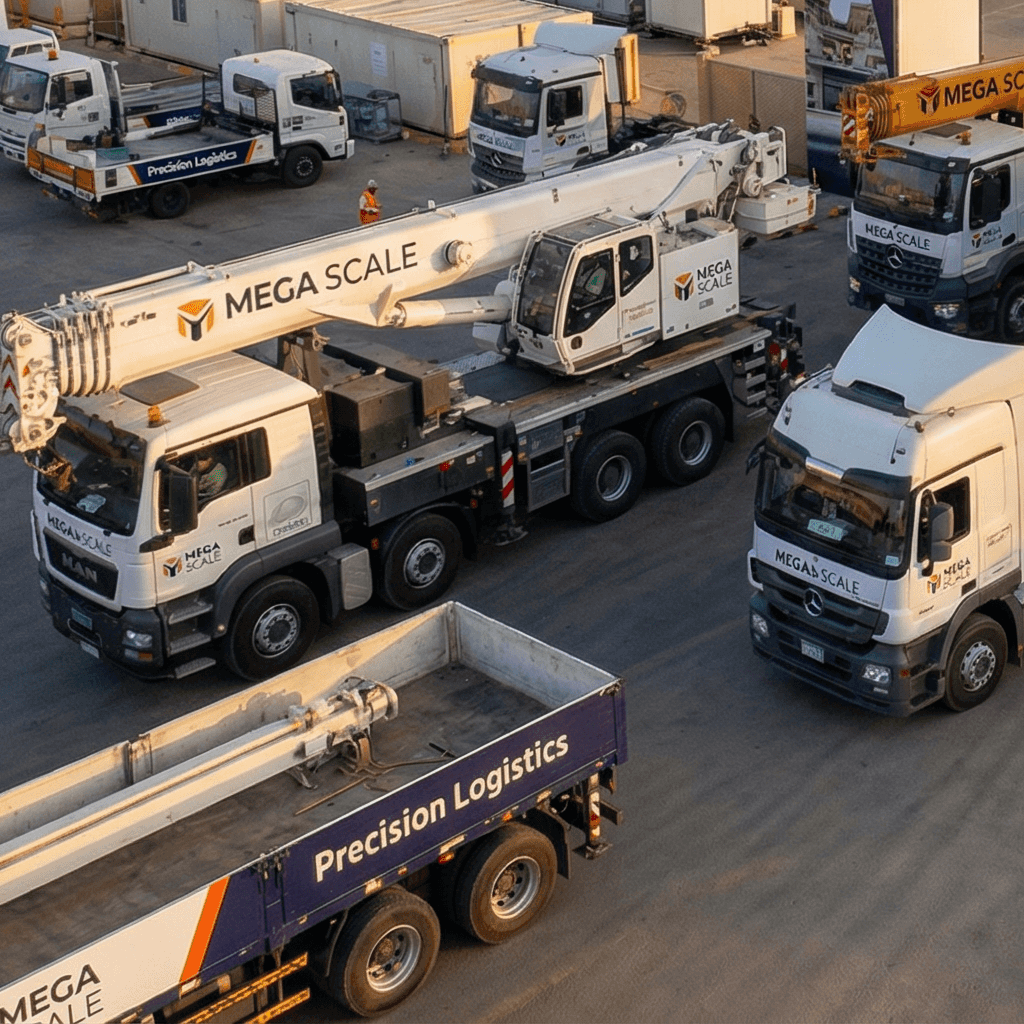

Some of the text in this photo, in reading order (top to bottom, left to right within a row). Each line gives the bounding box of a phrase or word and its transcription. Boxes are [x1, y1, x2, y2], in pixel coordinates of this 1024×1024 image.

[944, 77, 999, 107] MEGA
[896, 231, 931, 251] SCALE
[225, 241, 418, 319] MEGA SCALE
[821, 568, 860, 595] SCALE
[314, 733, 570, 883] Precision Logistics
[0, 963, 101, 1024] MEGA
[33, 988, 104, 1024] ALE
